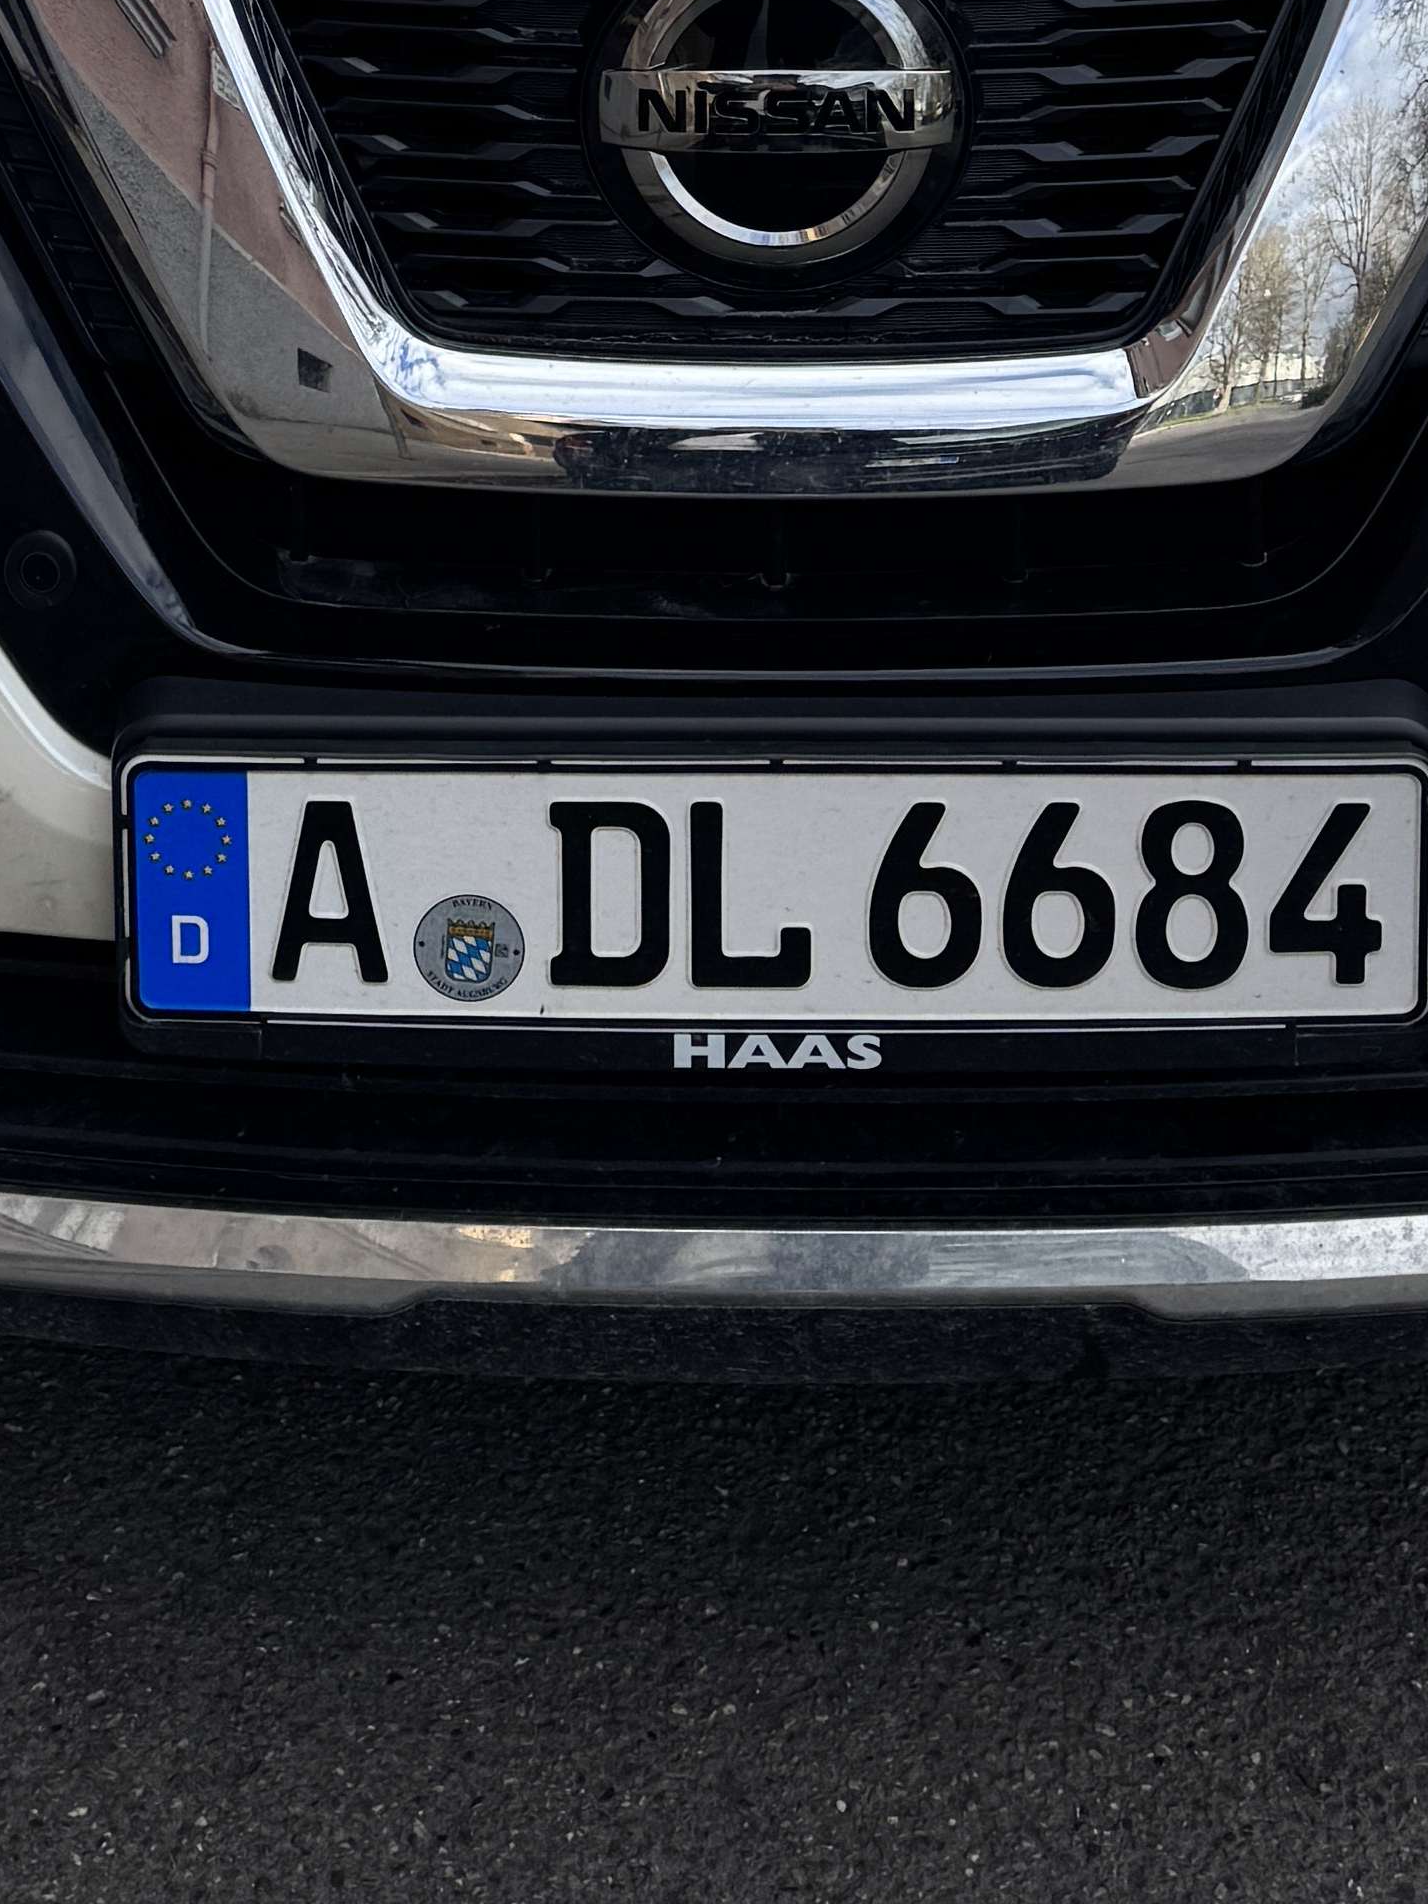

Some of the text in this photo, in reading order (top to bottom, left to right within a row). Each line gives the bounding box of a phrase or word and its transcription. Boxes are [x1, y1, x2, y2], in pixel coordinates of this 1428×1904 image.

[638, 88, 915, 136] NISSAN
[272, 799, 1383, 990] A DL 6684
[452, 898, 493, 911] BAYERN
[172, 915, 209, 964] D
[673, 1034, 883, 1070] HAAS
